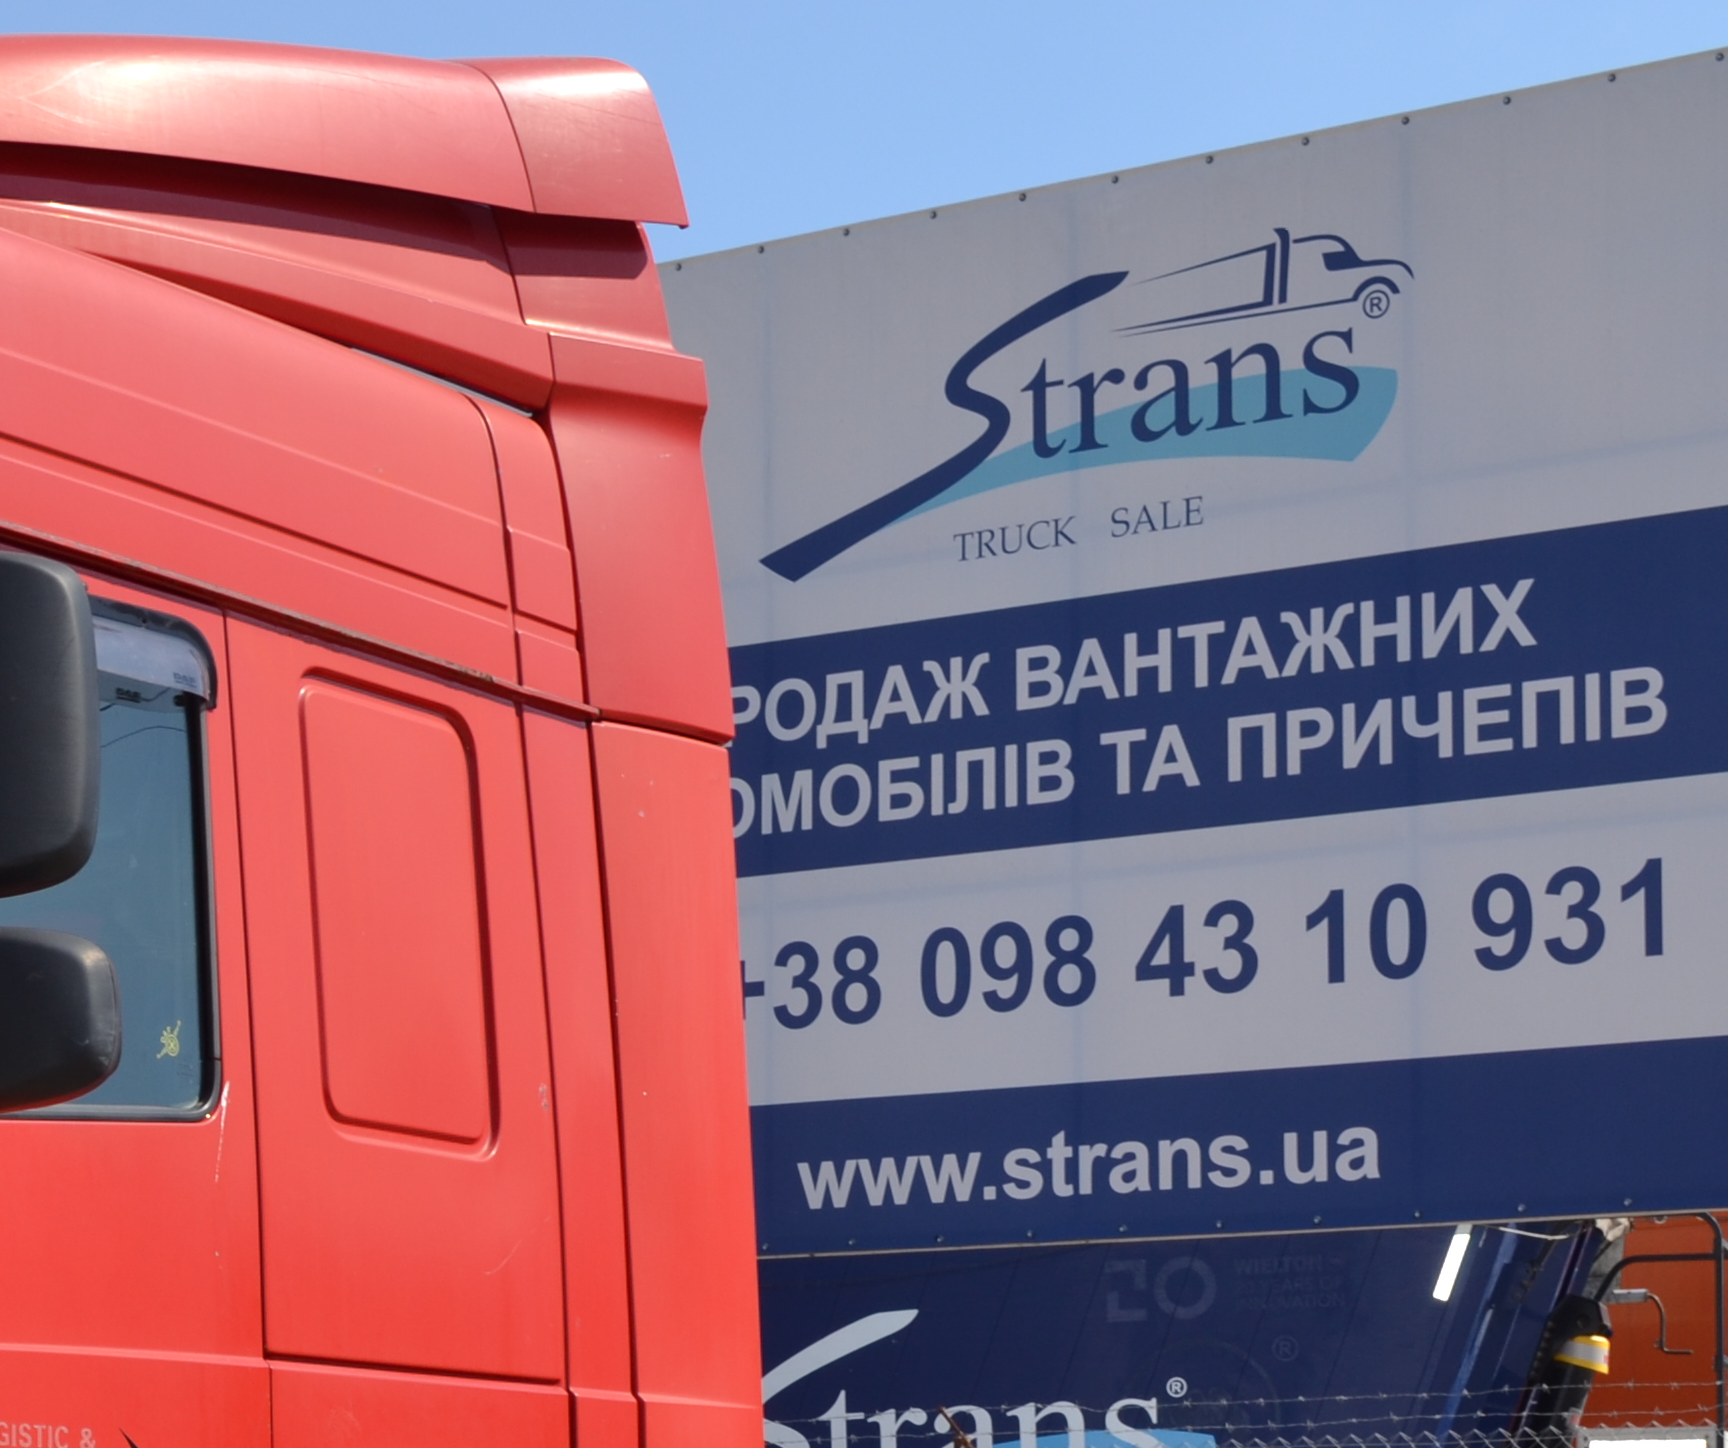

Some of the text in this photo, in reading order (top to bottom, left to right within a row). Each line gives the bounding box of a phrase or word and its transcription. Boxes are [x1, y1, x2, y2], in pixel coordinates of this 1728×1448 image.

[759, 271, 1361, 582] Strans
[953, 496, 1205, 563] TRUCK SALE
[1014, 576, 1538, 712] ВАНТАЖНИХ
[1100, 721, 1201, 796] ТА
[1226, 665, 1670, 785] ПРИЧЕПІВ
[919, 913, 1097, 1019] 098
[1134, 899, 1260, 998] 43
[1305, 882, 1428, 984] 10
[1471, 857, 1665, 972] 931
[797, 1123, 1382, 1210] www.strans.ua
